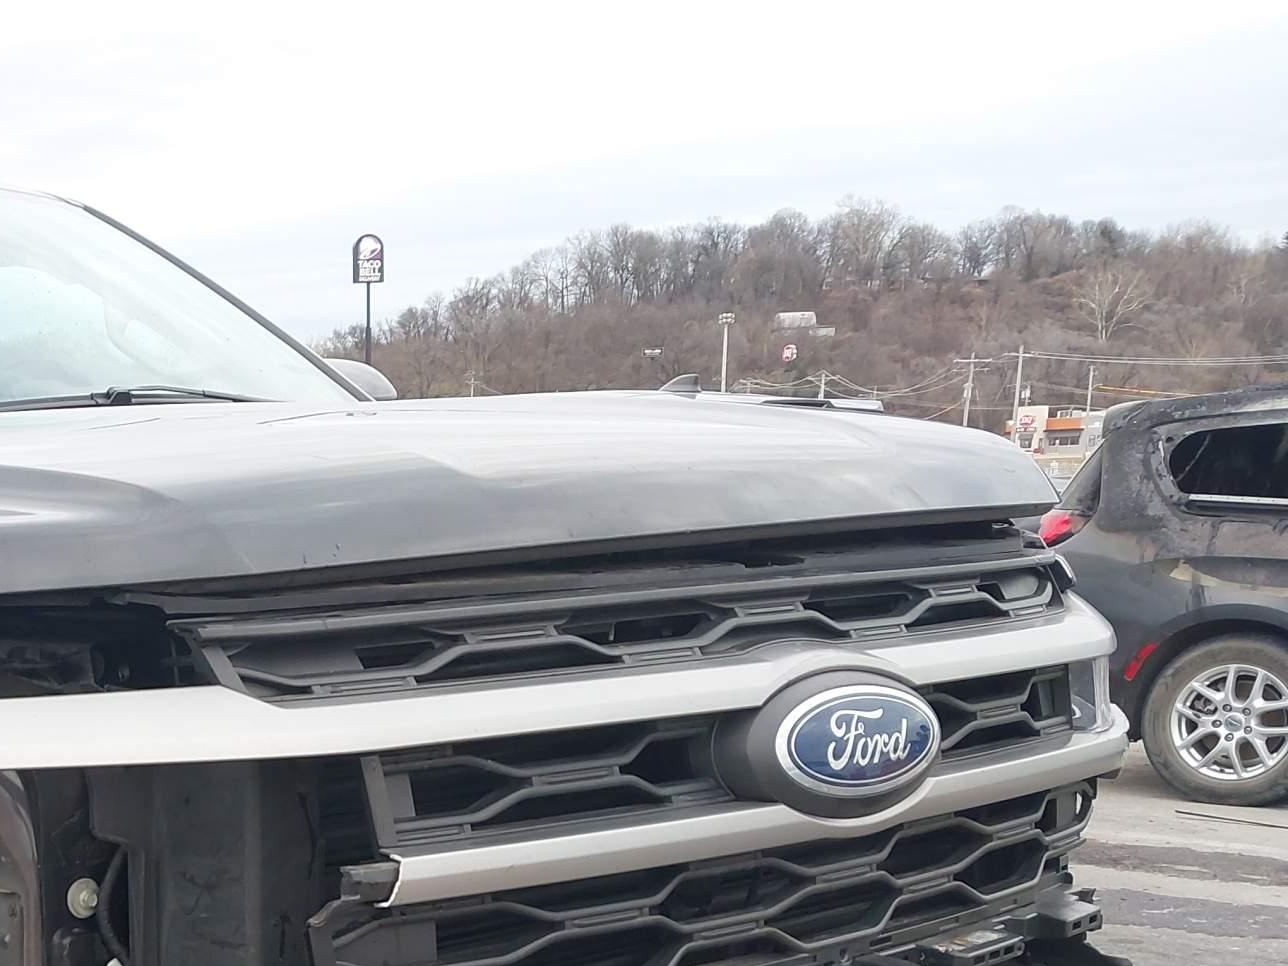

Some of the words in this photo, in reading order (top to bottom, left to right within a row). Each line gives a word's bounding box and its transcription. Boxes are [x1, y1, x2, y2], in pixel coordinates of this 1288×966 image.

[358, 259, 382, 267] TACO
[360, 267, 381, 275] BELL
[827, 708, 911, 771] Ford
